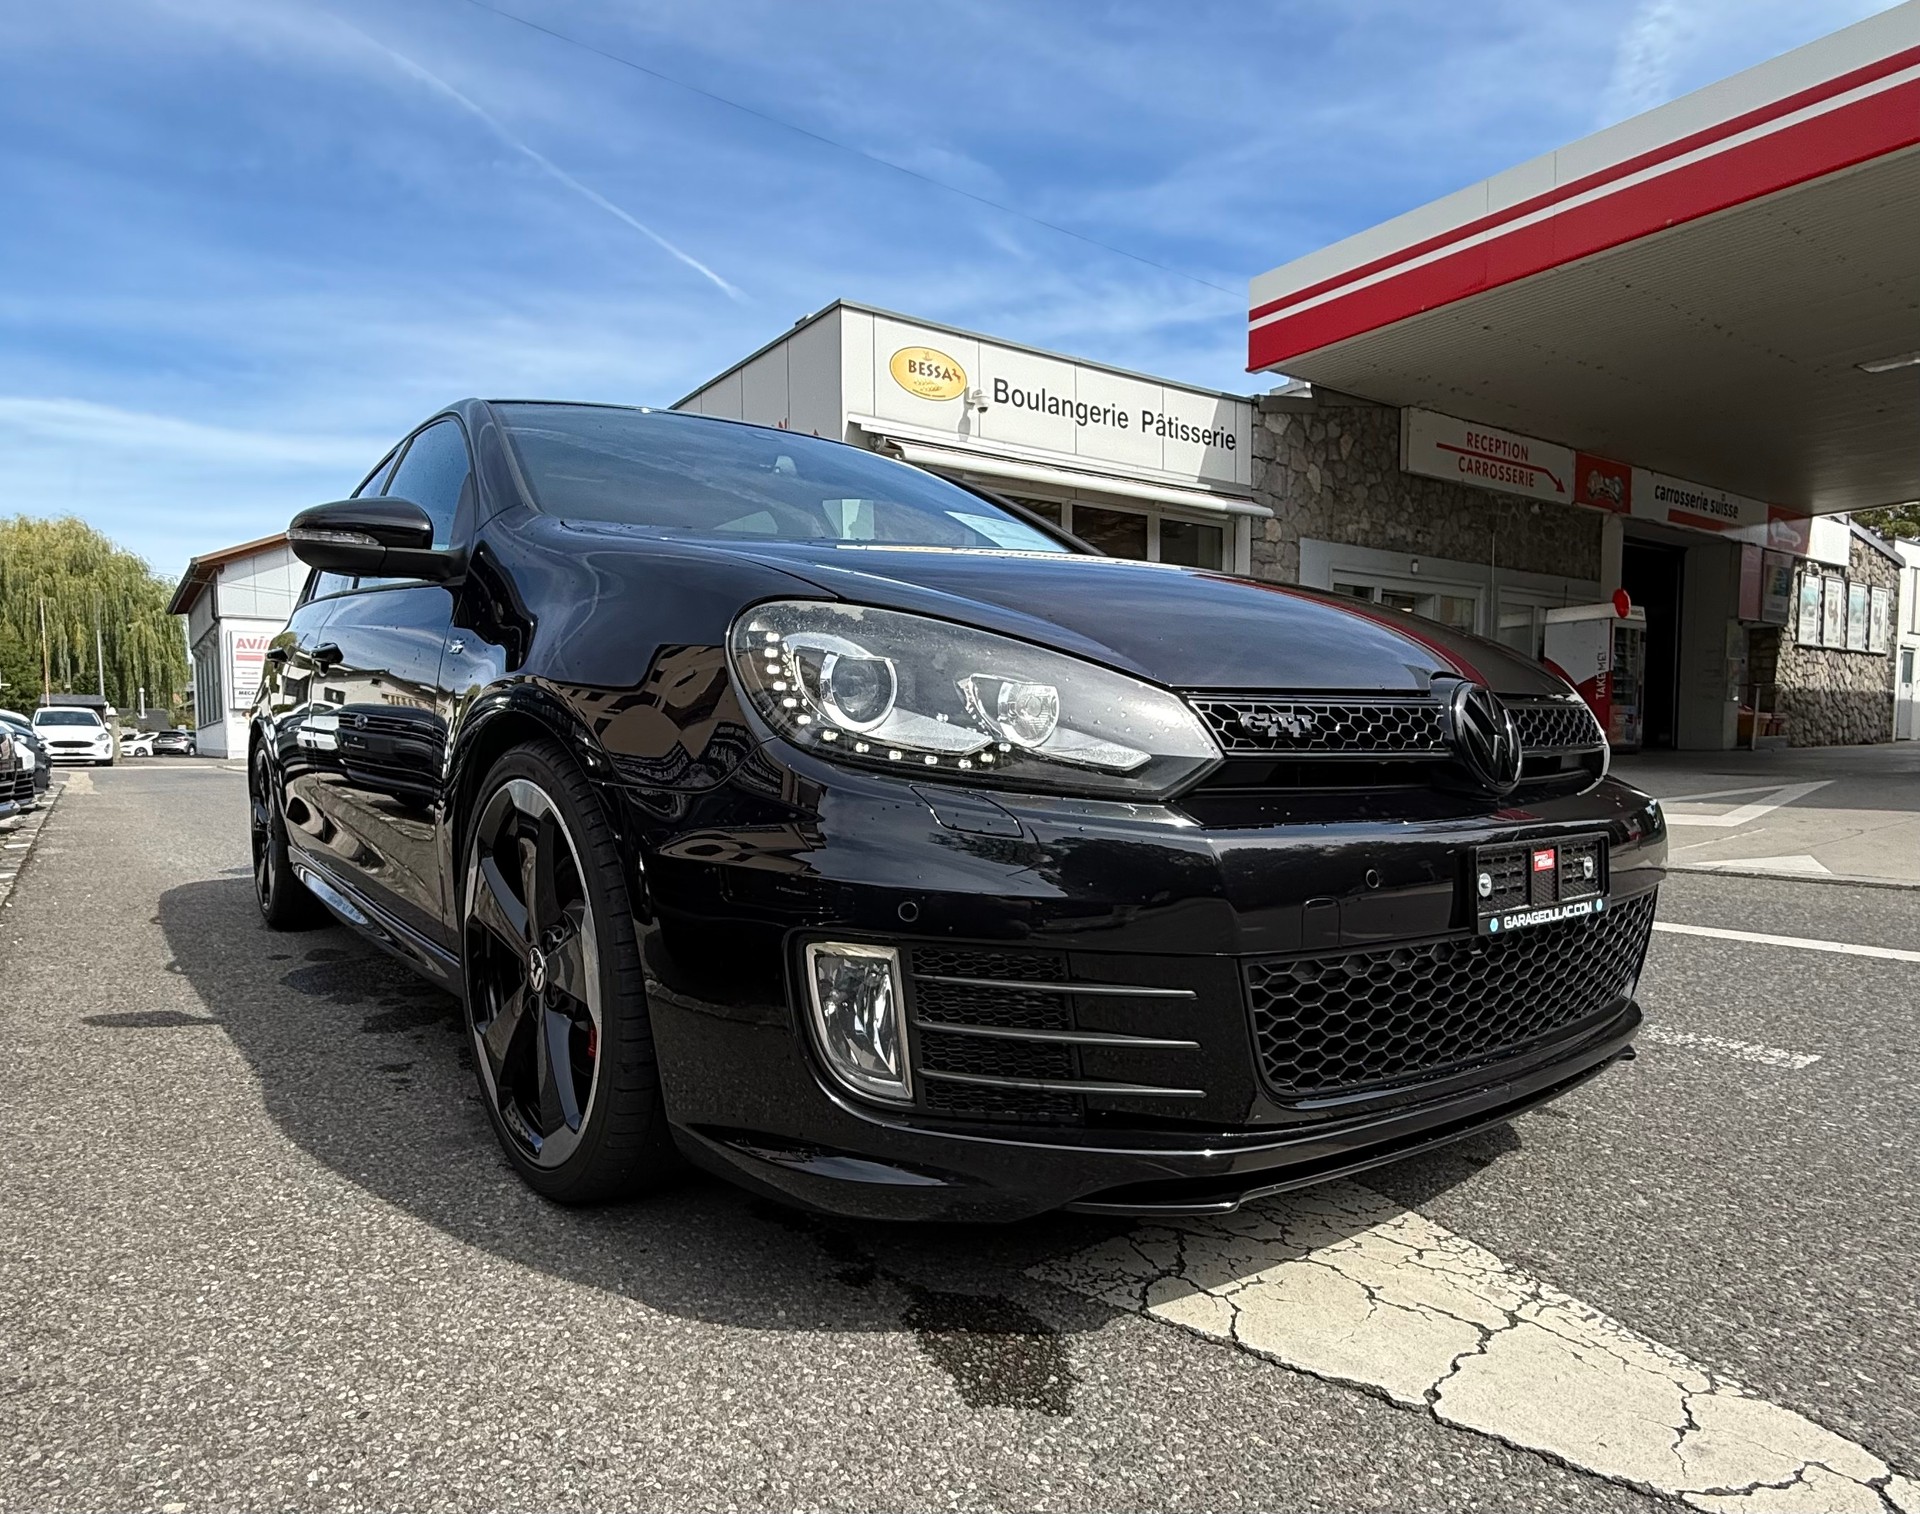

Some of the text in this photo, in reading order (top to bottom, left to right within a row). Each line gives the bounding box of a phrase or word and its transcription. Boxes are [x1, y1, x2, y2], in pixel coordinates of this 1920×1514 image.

[908, 359, 953, 382] BESSA
[992, 377, 1129, 429] Boulangerie
[1141, 410, 1237, 451] Pâtisserie
[1466, 431, 1529, 462] RECEPTION
[1458, 456, 1535, 488] CARROSSERIE
[1654, 484, 1739, 519] carrosserie suisse
[1595, 672, 1607, 700] TAKE
[1503, 901, 1593, 930] GARAGEDULAC.COM
